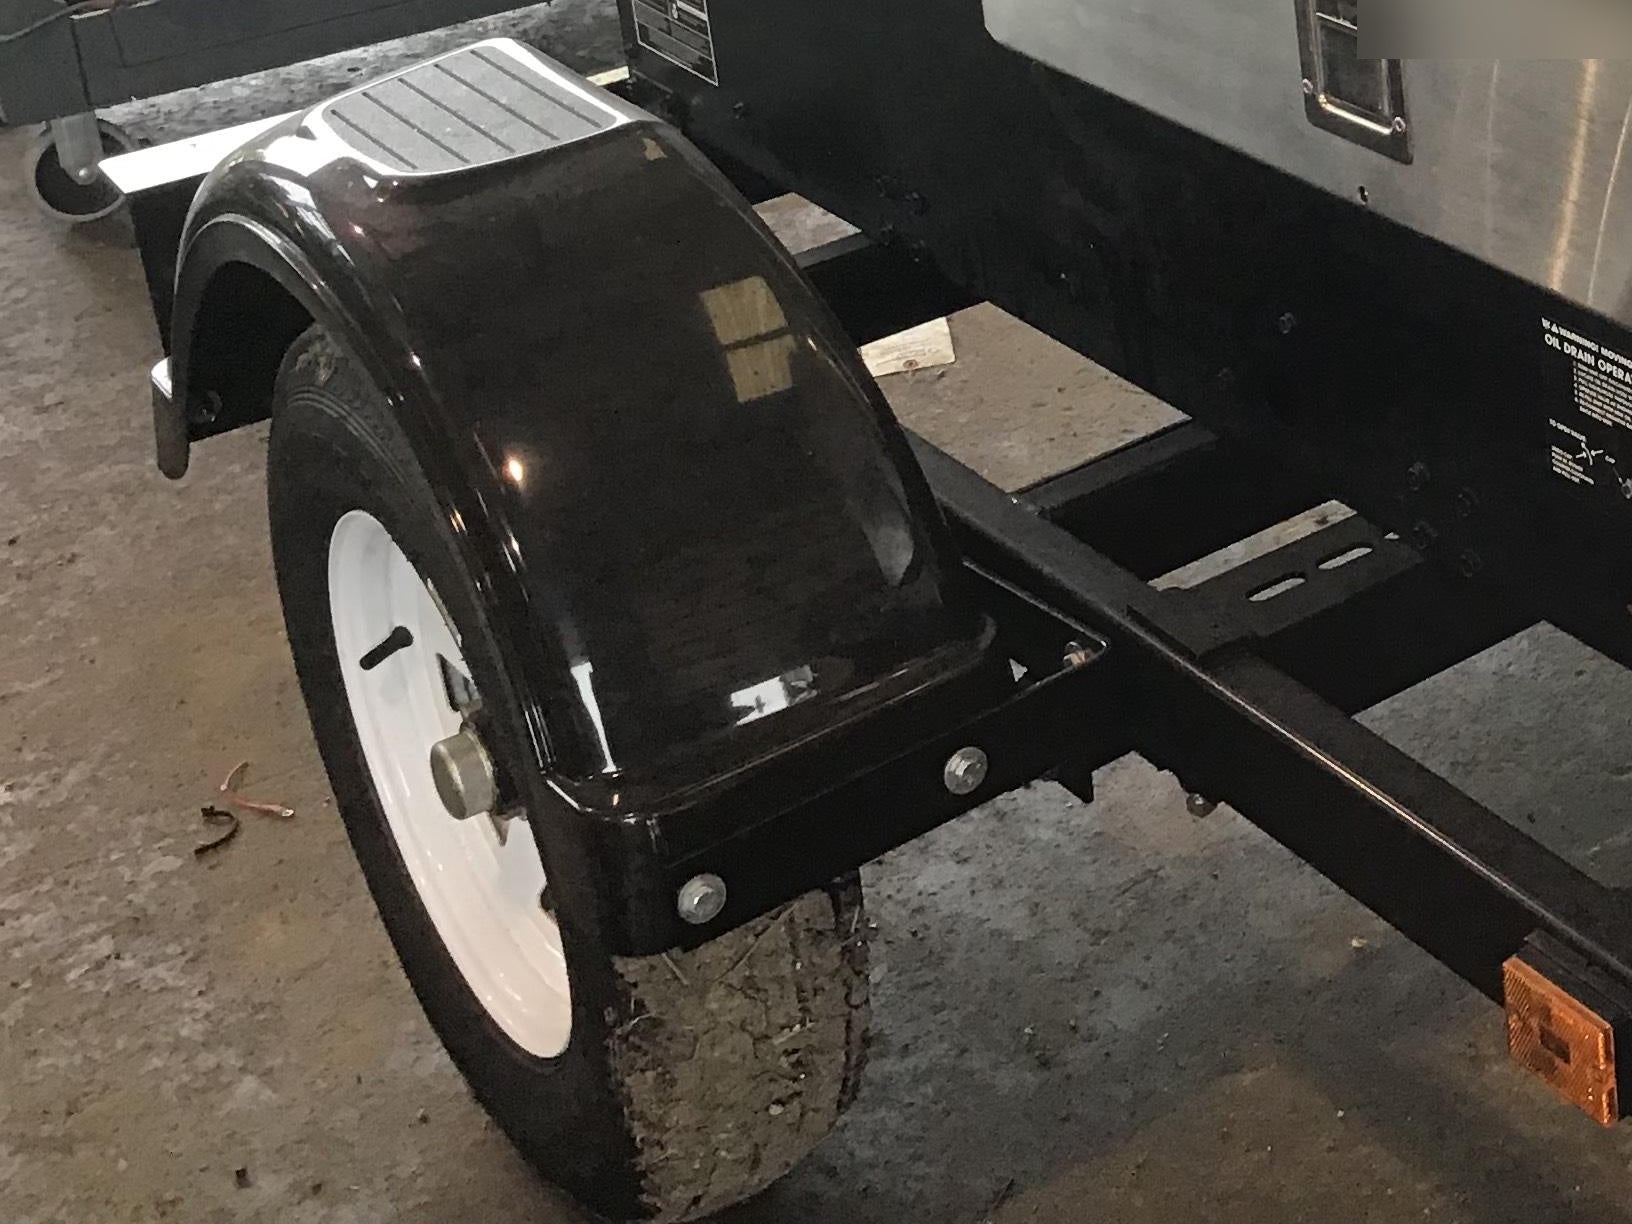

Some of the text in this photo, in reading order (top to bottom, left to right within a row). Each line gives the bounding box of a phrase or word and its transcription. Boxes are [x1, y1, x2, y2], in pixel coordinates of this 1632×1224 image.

[1545, 333, 1561, 350] OIL
[1564, 341, 1595, 366] DRAIN
[1601, 346, 1632, 369] MOVING
